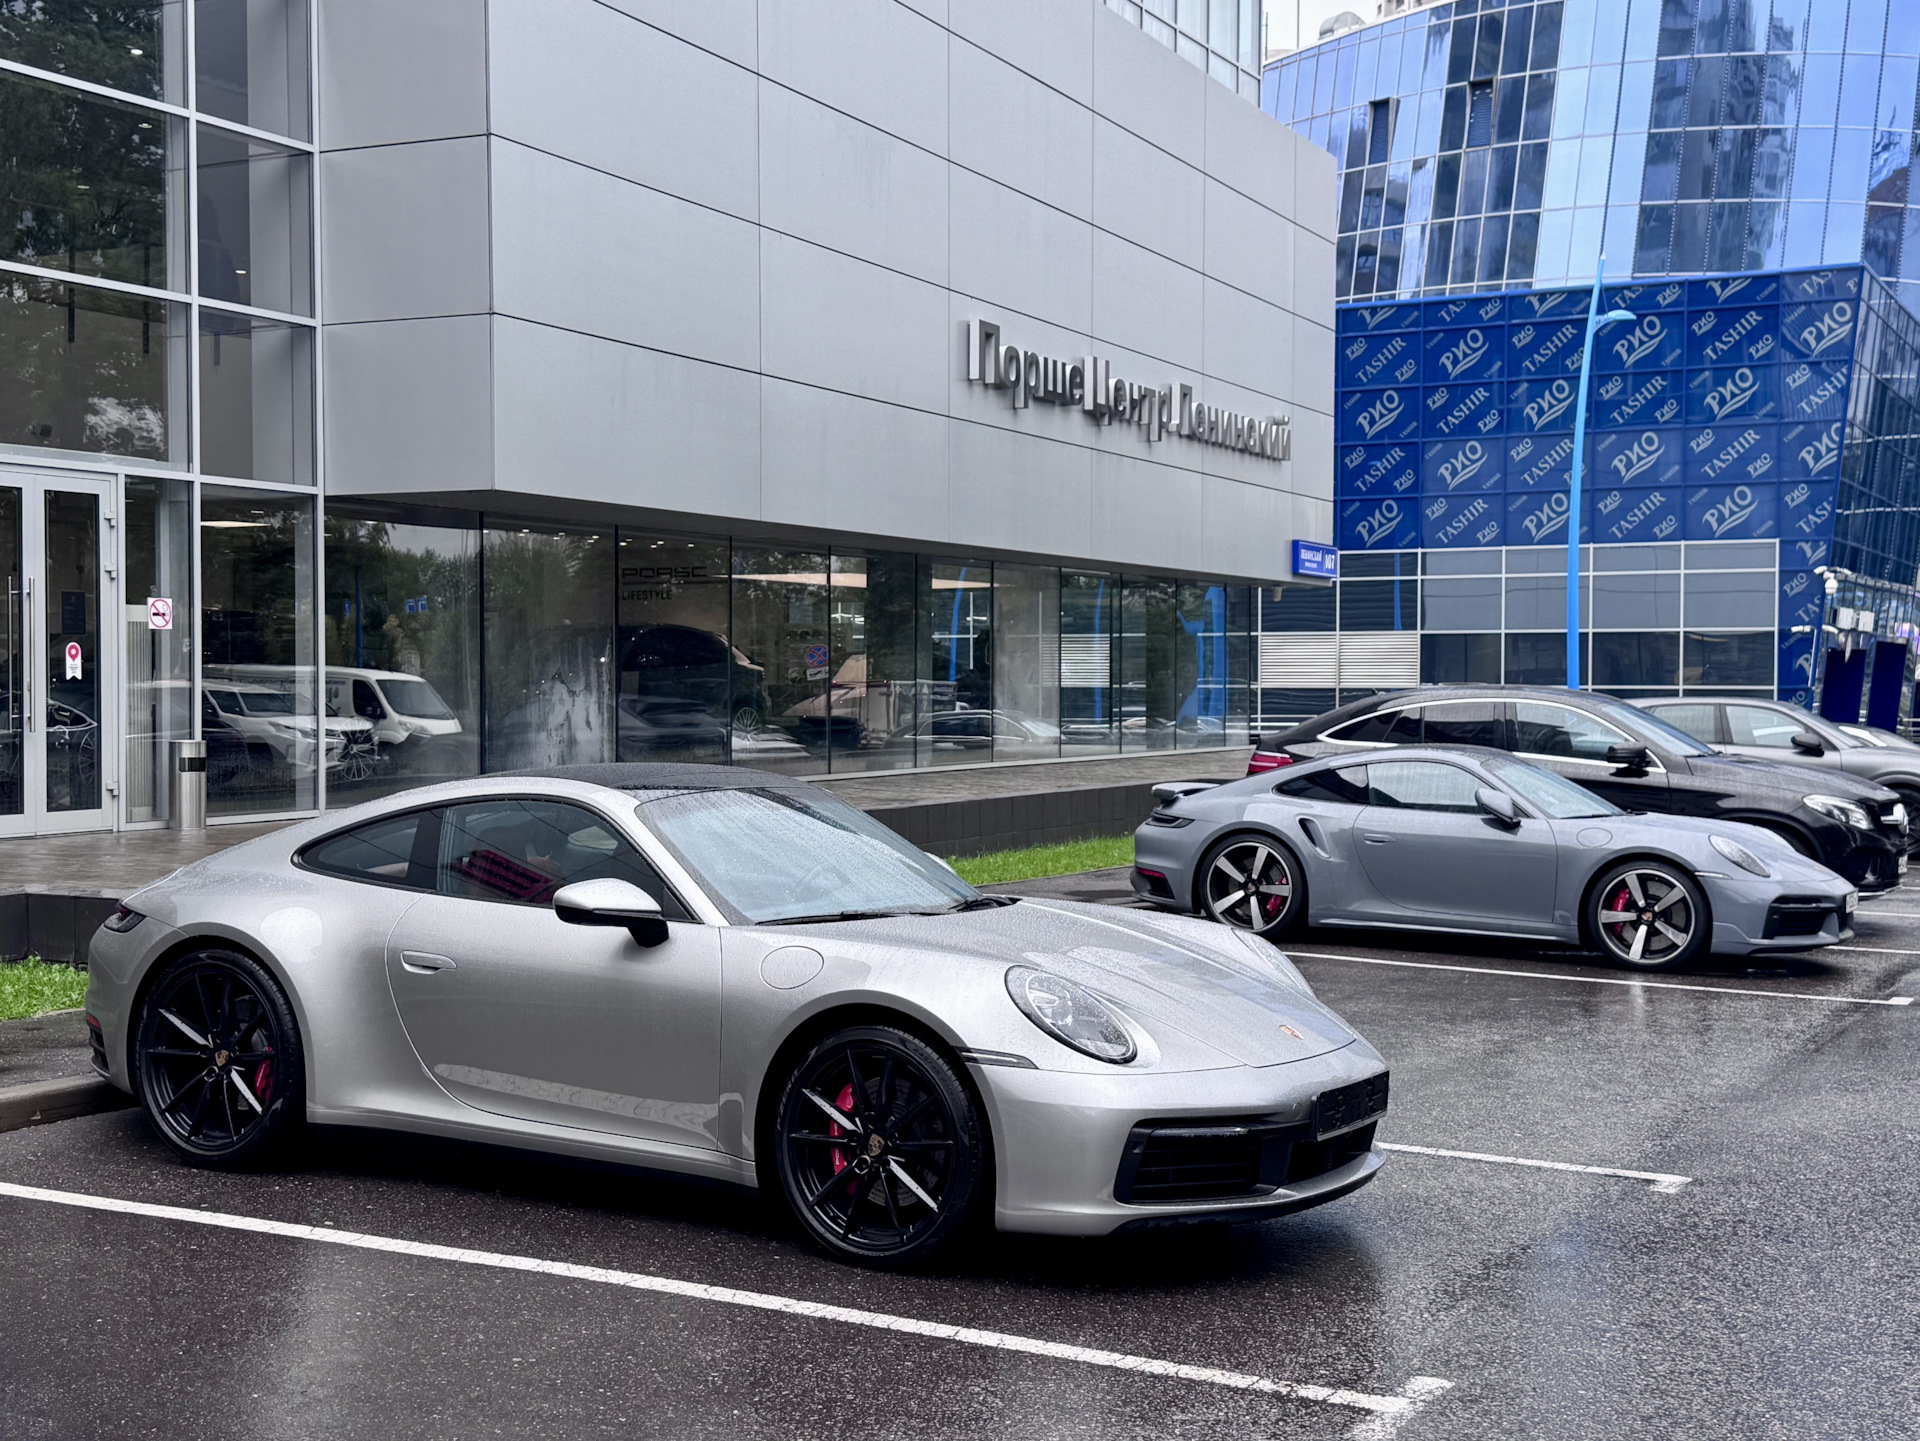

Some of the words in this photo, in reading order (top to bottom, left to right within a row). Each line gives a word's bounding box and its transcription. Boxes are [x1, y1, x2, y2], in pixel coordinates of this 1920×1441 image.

[1522, 324, 1578, 373] TASHIR
[1613, 315, 1661, 361] РИО
[1703, 310, 1763, 360] TASHIR
[1800, 302, 1851, 350] РИО
[1355, 337, 1407, 383] TASHIR
[1439, 329, 1483, 374] РИО
[967, 319, 1083, 409] Порше
[1083, 356, 1170, 442] Центр
[1169, 383, 1291, 461] Ленинский
[1356, 390, 1399, 433] РИО
[1436, 387, 1490, 434] TASHIR
[1523, 379, 1570, 427] РИО
[1610, 375, 1668, 424] TASHIR
[1703, 367, 1753, 415] РИО
[1354, 447, 1405, 492] TASHIR
[1438, 441, 1482, 487] РИО
[1521, 438, 1575, 486] TASHIR
[1611, 431, 1659, 477] РИО
[1702, 429, 1760, 479] TASHIR
[1355, 500, 1398, 542] РИО
[1436, 498, 1489, 544] TASHIR
[1522, 492, 1567, 540] РИО
[1609, 491, 1666, 539] TASHIR
[1702, 486, 1752, 533] РИО
[622, 566, 707, 578] PORSC
[1325, 553, 1335, 569] 107
[622, 590, 672, 600] LIFESTYLE
